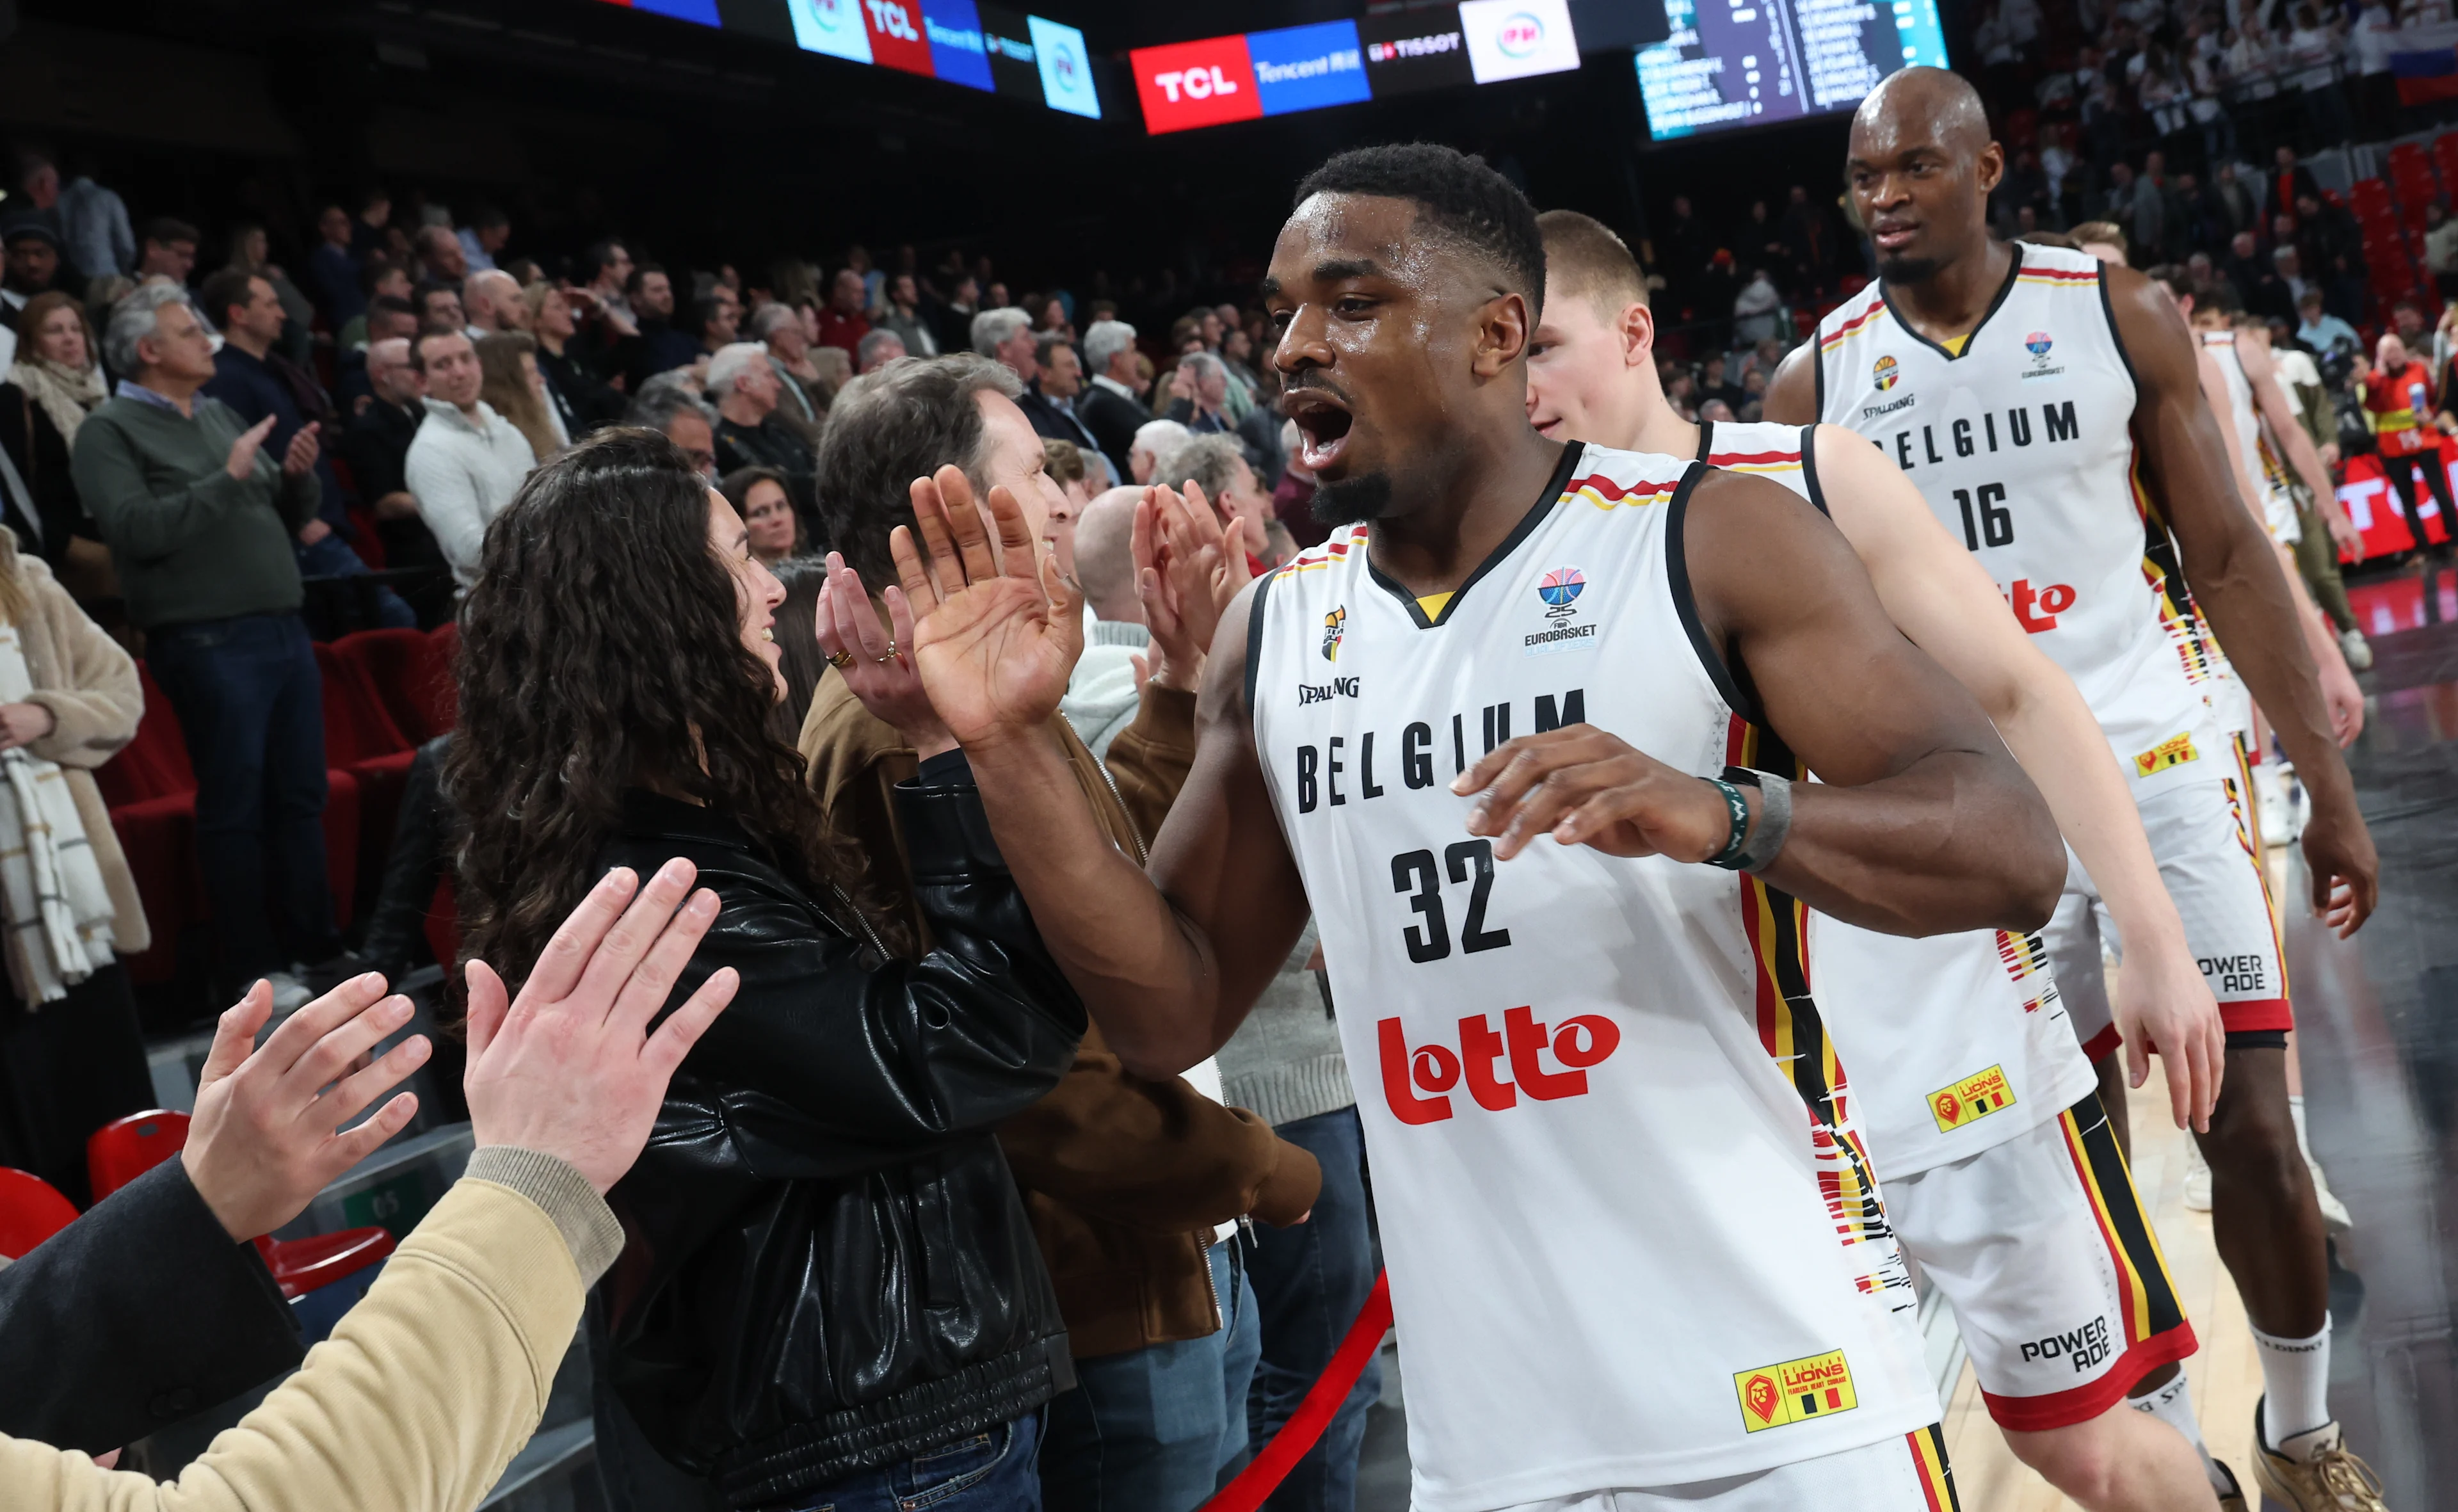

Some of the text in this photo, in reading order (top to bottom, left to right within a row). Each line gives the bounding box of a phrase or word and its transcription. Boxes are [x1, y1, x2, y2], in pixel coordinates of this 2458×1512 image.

[867, 0, 919, 42] TCL
[1395, 32, 1460, 58] TISSOT
[1156, 66, 1237, 102] TCL
[1863, 392, 1915, 421] SPALDING
[1871, 401, 2079, 470] ELGIUM
[1953, 482, 2014, 551] 16
[1525, 624, 1596, 647] EUROBASKET
[1391, 839, 1511, 963] 32
[2196, 955, 2263, 976] OWER
[2223, 973, 2265, 992] ADE
[1961, 1075, 2001, 1097] LIONS
[2020, 1315, 2107, 1362] POWER
[1783, 1356, 1841, 1375] BELGIAN
[2073, 1334, 2110, 1372] ADE
[1785, 1364, 1844, 1386] LIONS
[1788, 1376, 1847, 1395] FEARLESS HEART COURAGE
